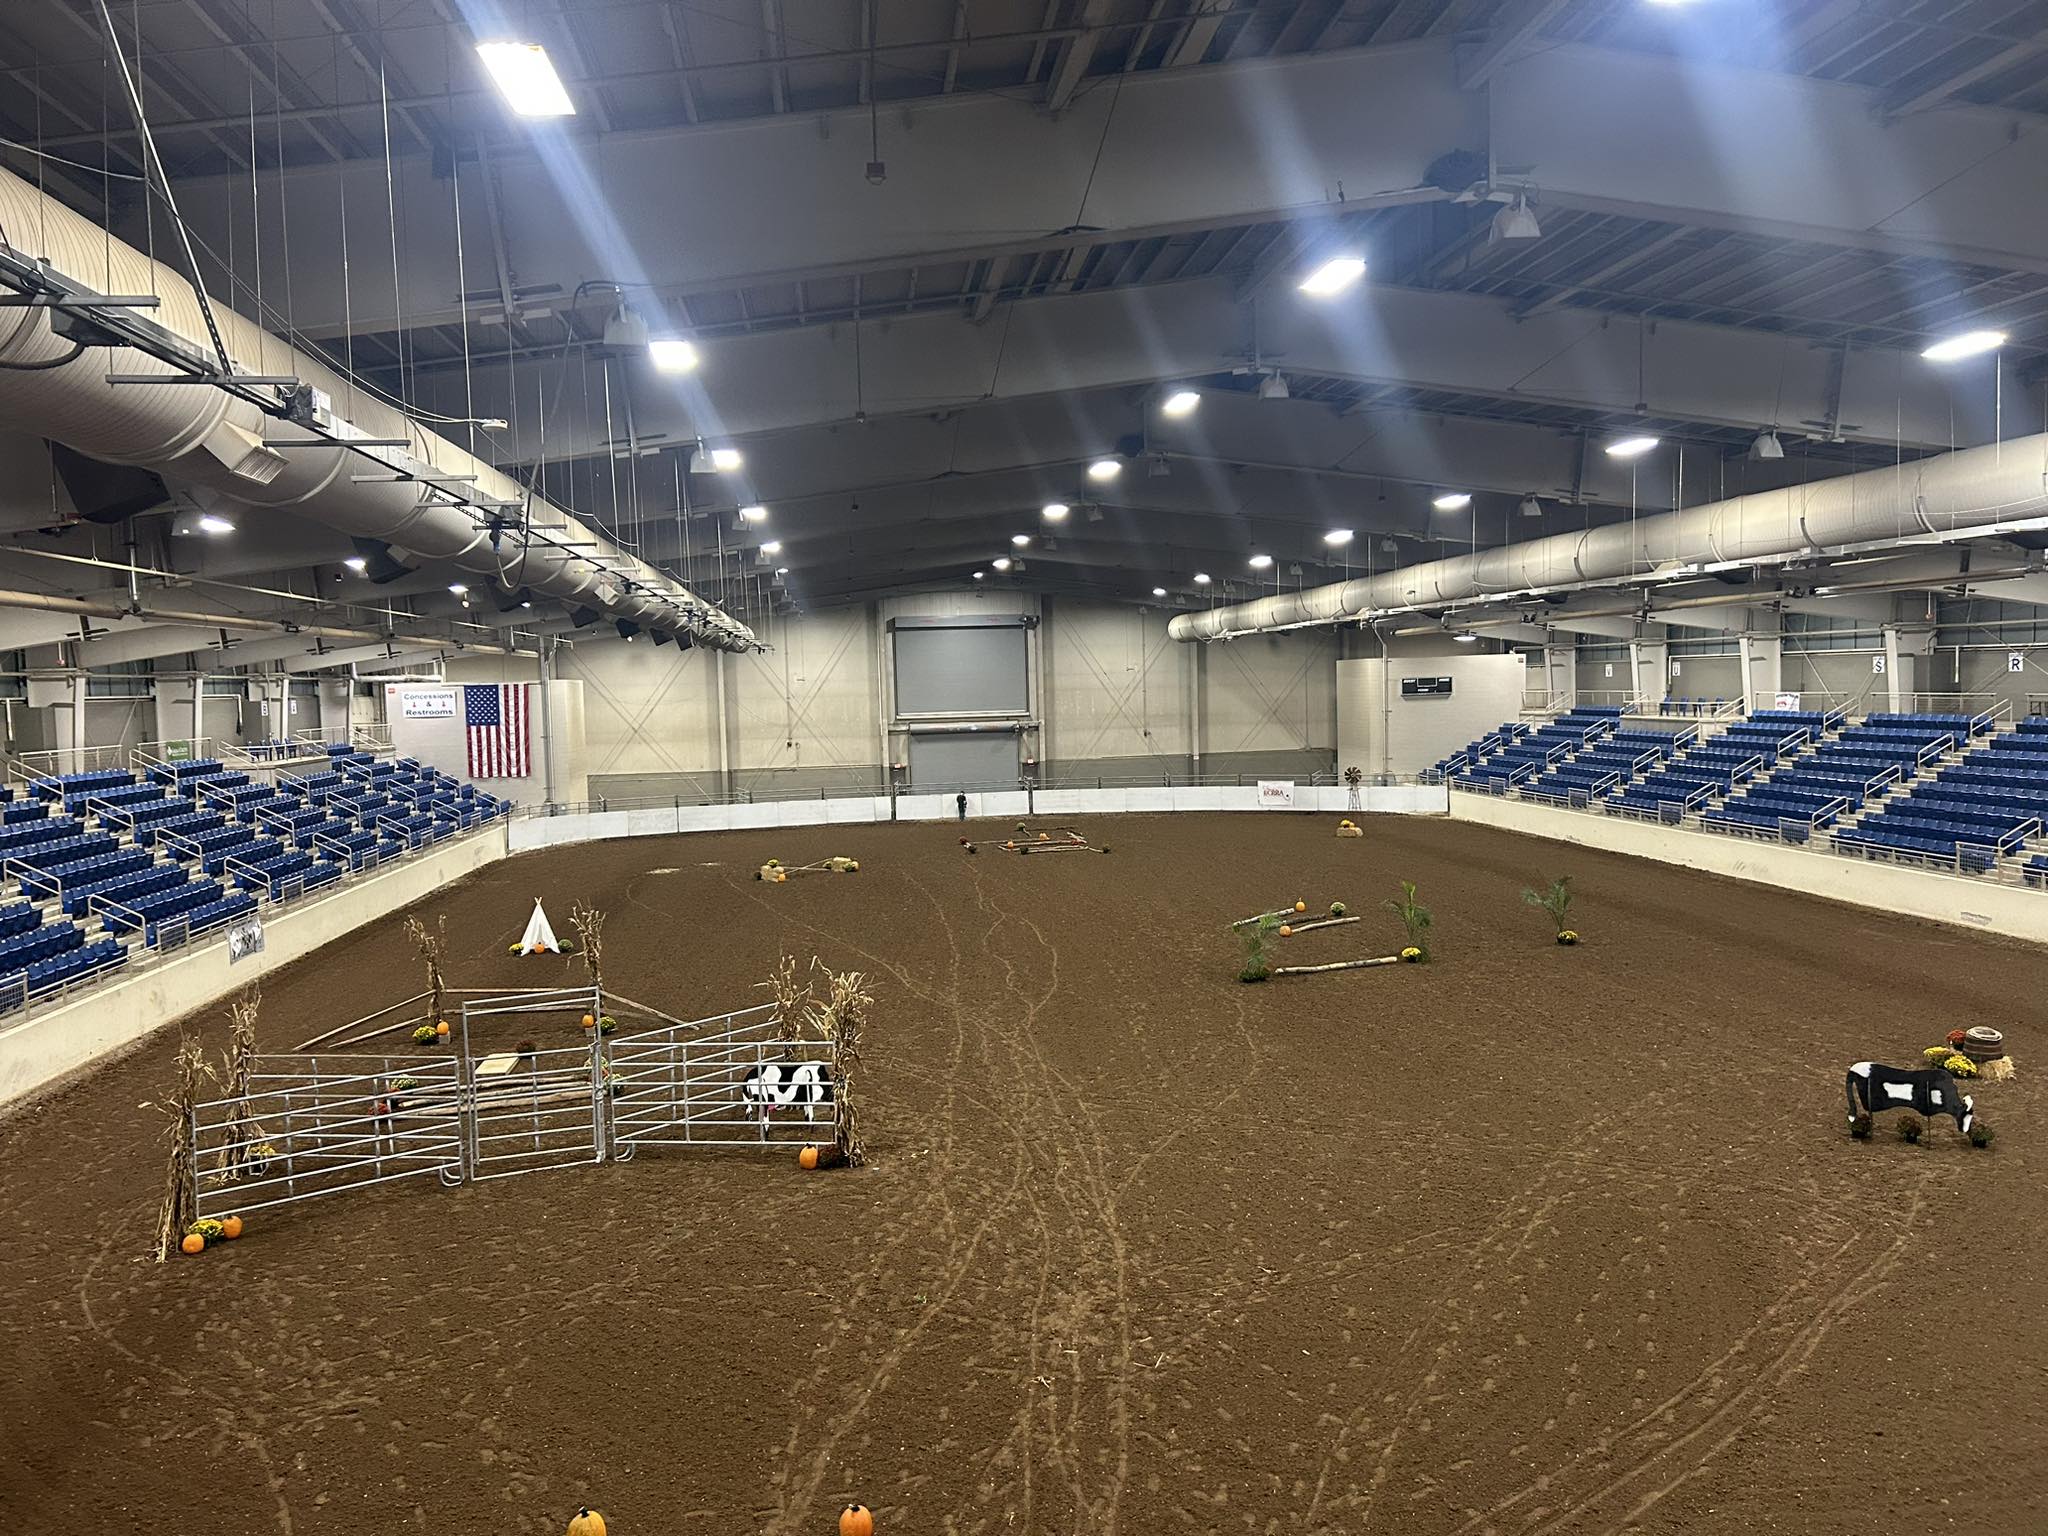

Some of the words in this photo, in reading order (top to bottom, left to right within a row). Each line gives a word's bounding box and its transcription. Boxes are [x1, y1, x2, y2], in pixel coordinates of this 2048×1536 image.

[1876, 661, 1882, 672] S
[2012, 658, 2020, 670] R
[1673, 666, 1679, 675] U
